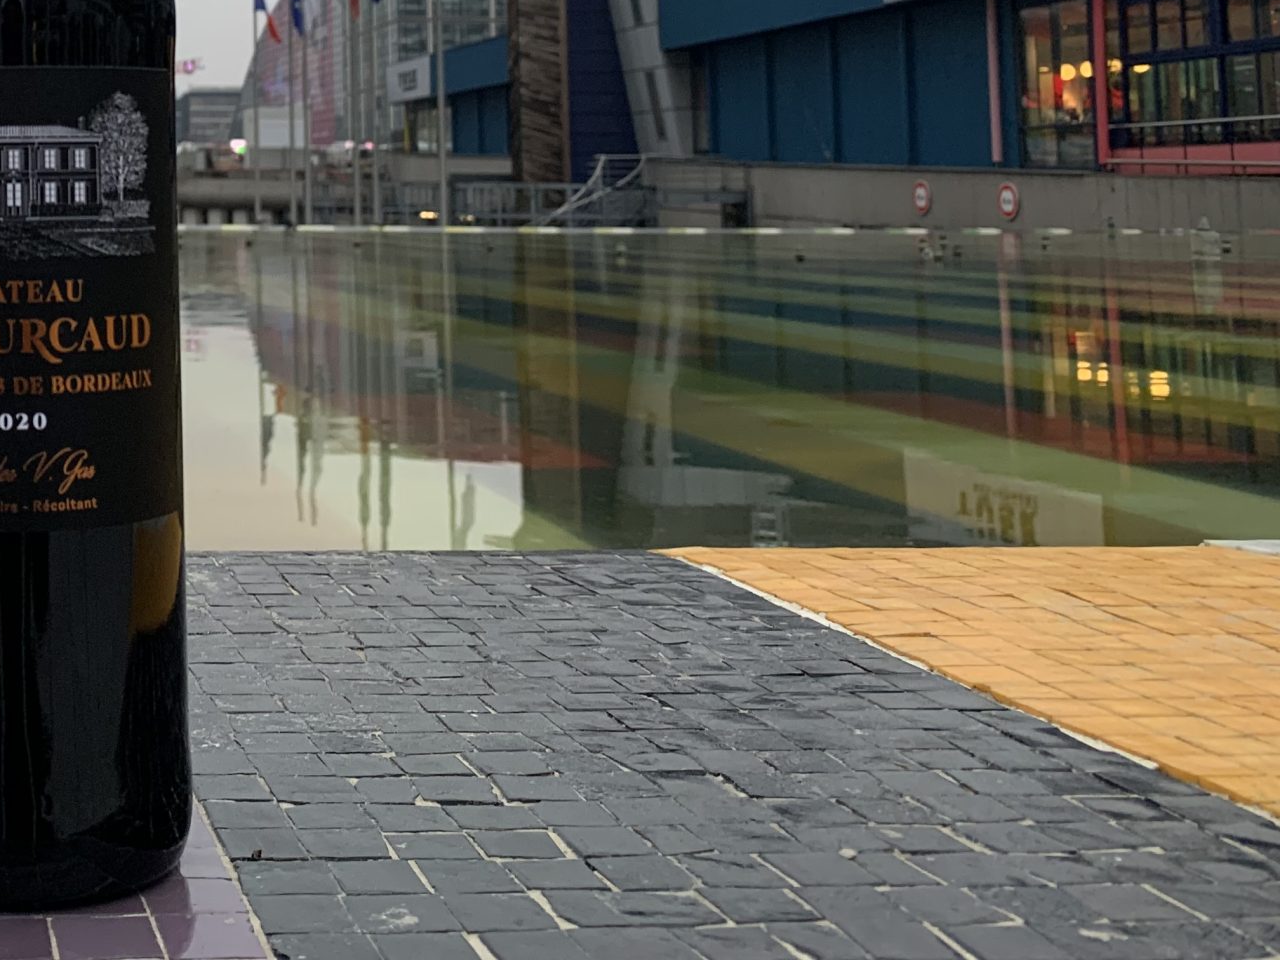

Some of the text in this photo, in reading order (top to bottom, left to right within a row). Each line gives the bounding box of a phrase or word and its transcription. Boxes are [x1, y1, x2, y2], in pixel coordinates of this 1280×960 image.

[13, 376, 44, 396] DE
[51, 369, 153, 395] BORDEAUX
[32, 496, 99, 513] Récoltant
